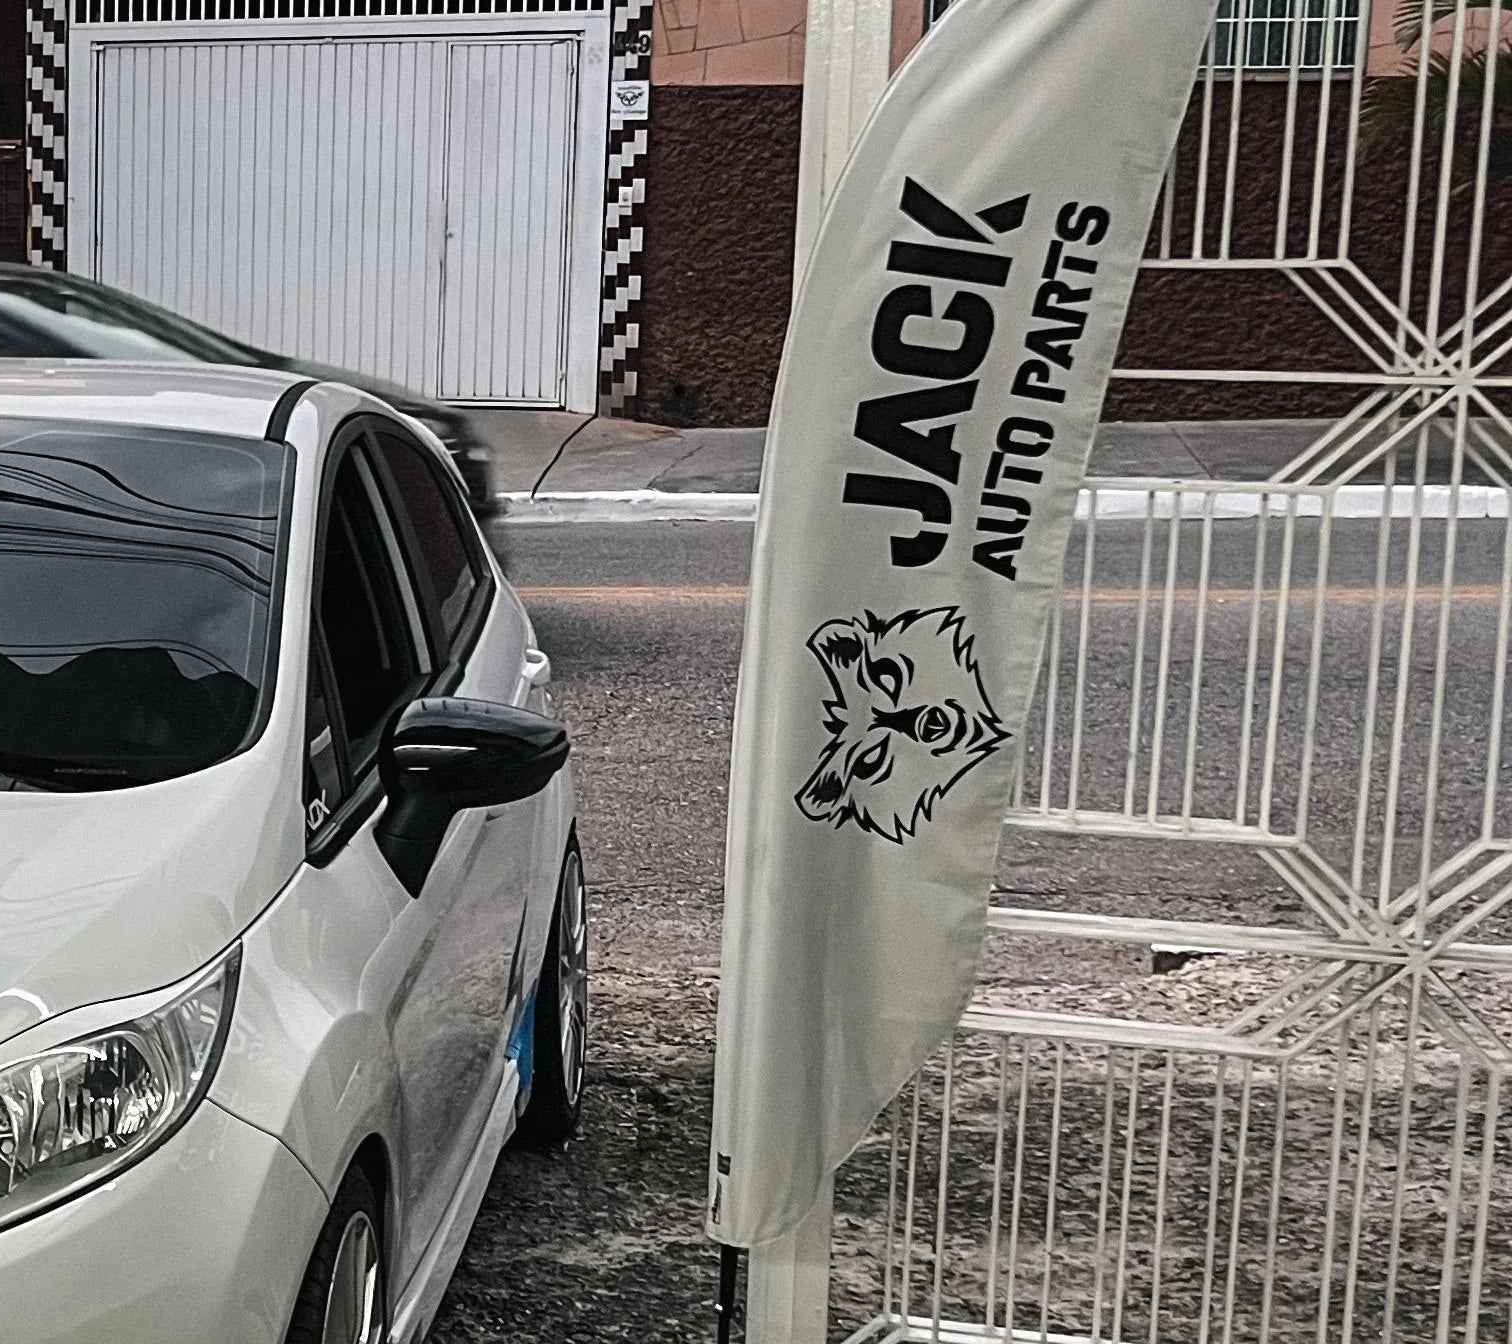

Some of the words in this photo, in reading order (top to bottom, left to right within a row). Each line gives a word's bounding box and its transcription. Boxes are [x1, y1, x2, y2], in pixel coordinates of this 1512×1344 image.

[842, 176, 1030, 568] JACK
[1011, 200, 1111, 404] PARTS
[971, 416, 1055, 581] AUTO
